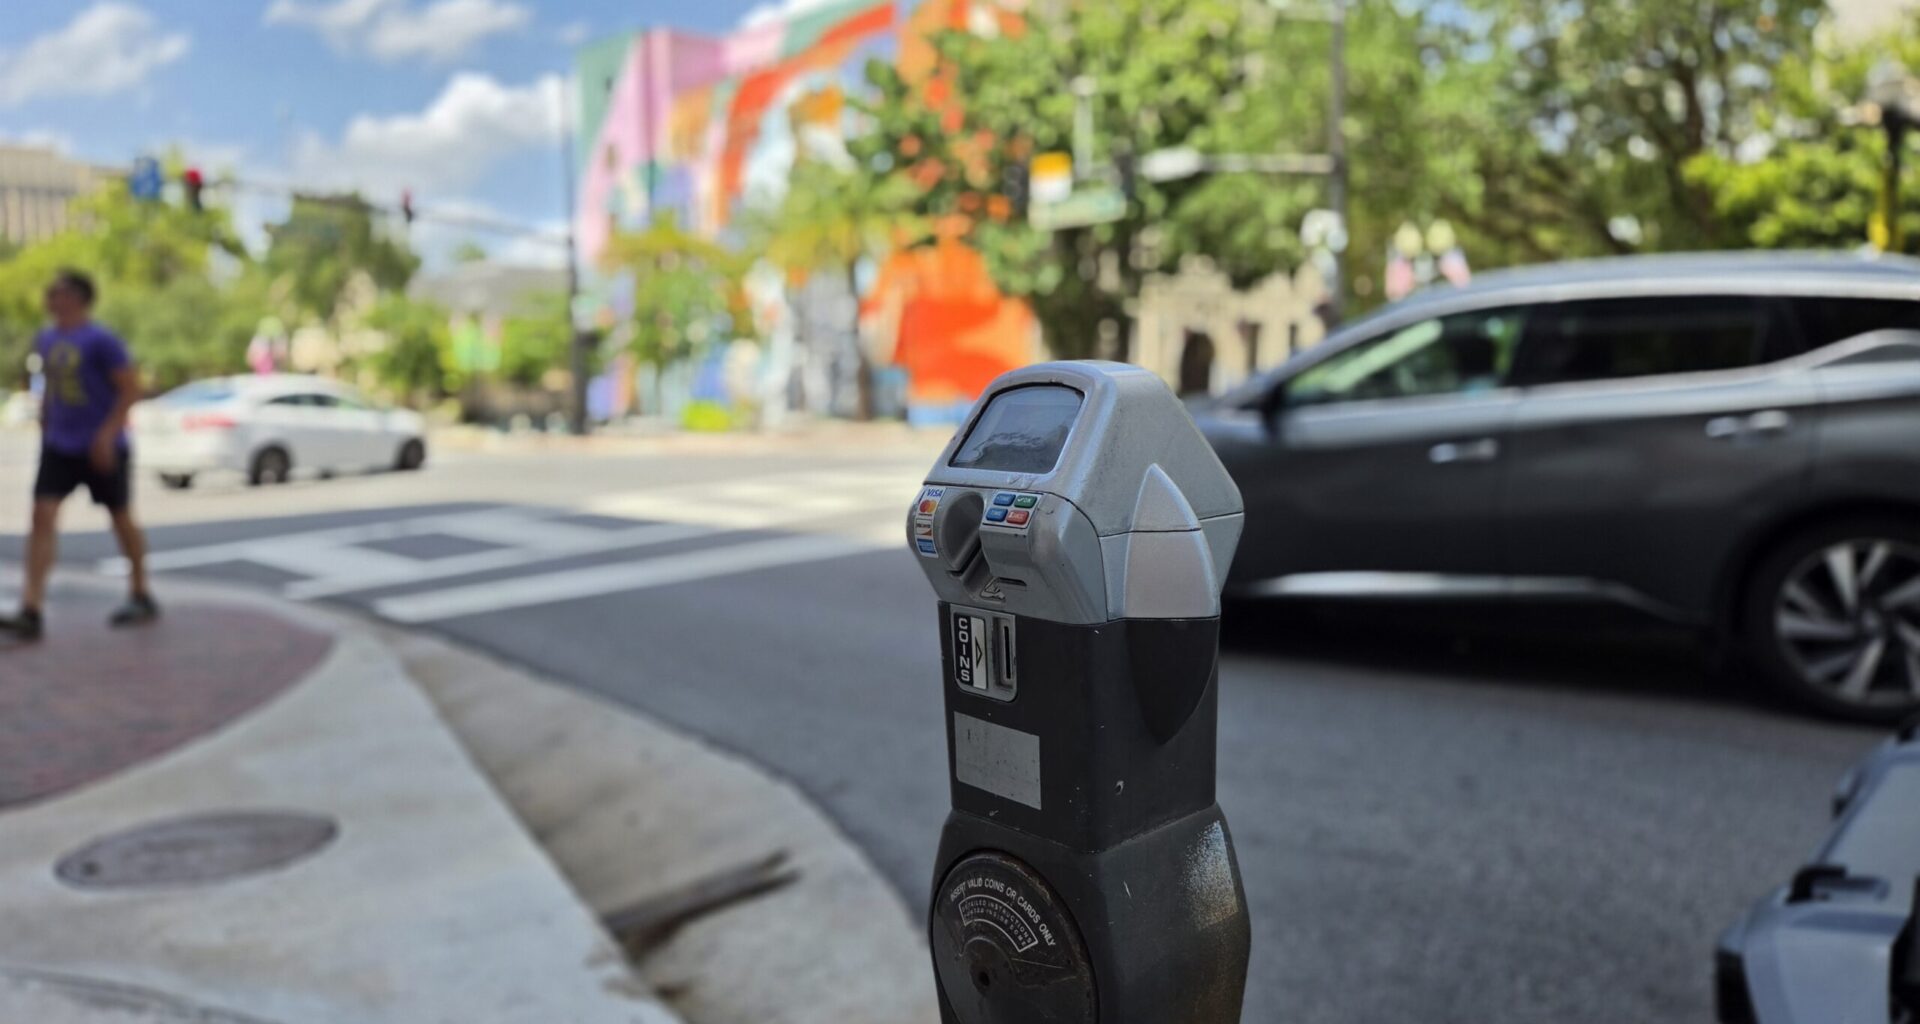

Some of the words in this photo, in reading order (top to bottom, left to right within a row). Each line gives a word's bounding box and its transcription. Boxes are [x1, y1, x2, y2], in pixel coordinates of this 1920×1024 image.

[927, 488, 944, 497] VISA
[958, 617, 970, 682] COINS
[950, 881, 966, 902] INSERT
[967, 877, 983, 889] VALID
[984, 878, 1005, 893] COINS
[1005, 887, 1017, 900] OR
[1017, 896, 1041, 924] CARDS
[1039, 923, 1057, 946] ONLY
[962, 900, 987, 912] DETAILED
[988, 901, 1033, 944] INSTRUCTIONS
[986, 908, 1008, 926] INSIDE
